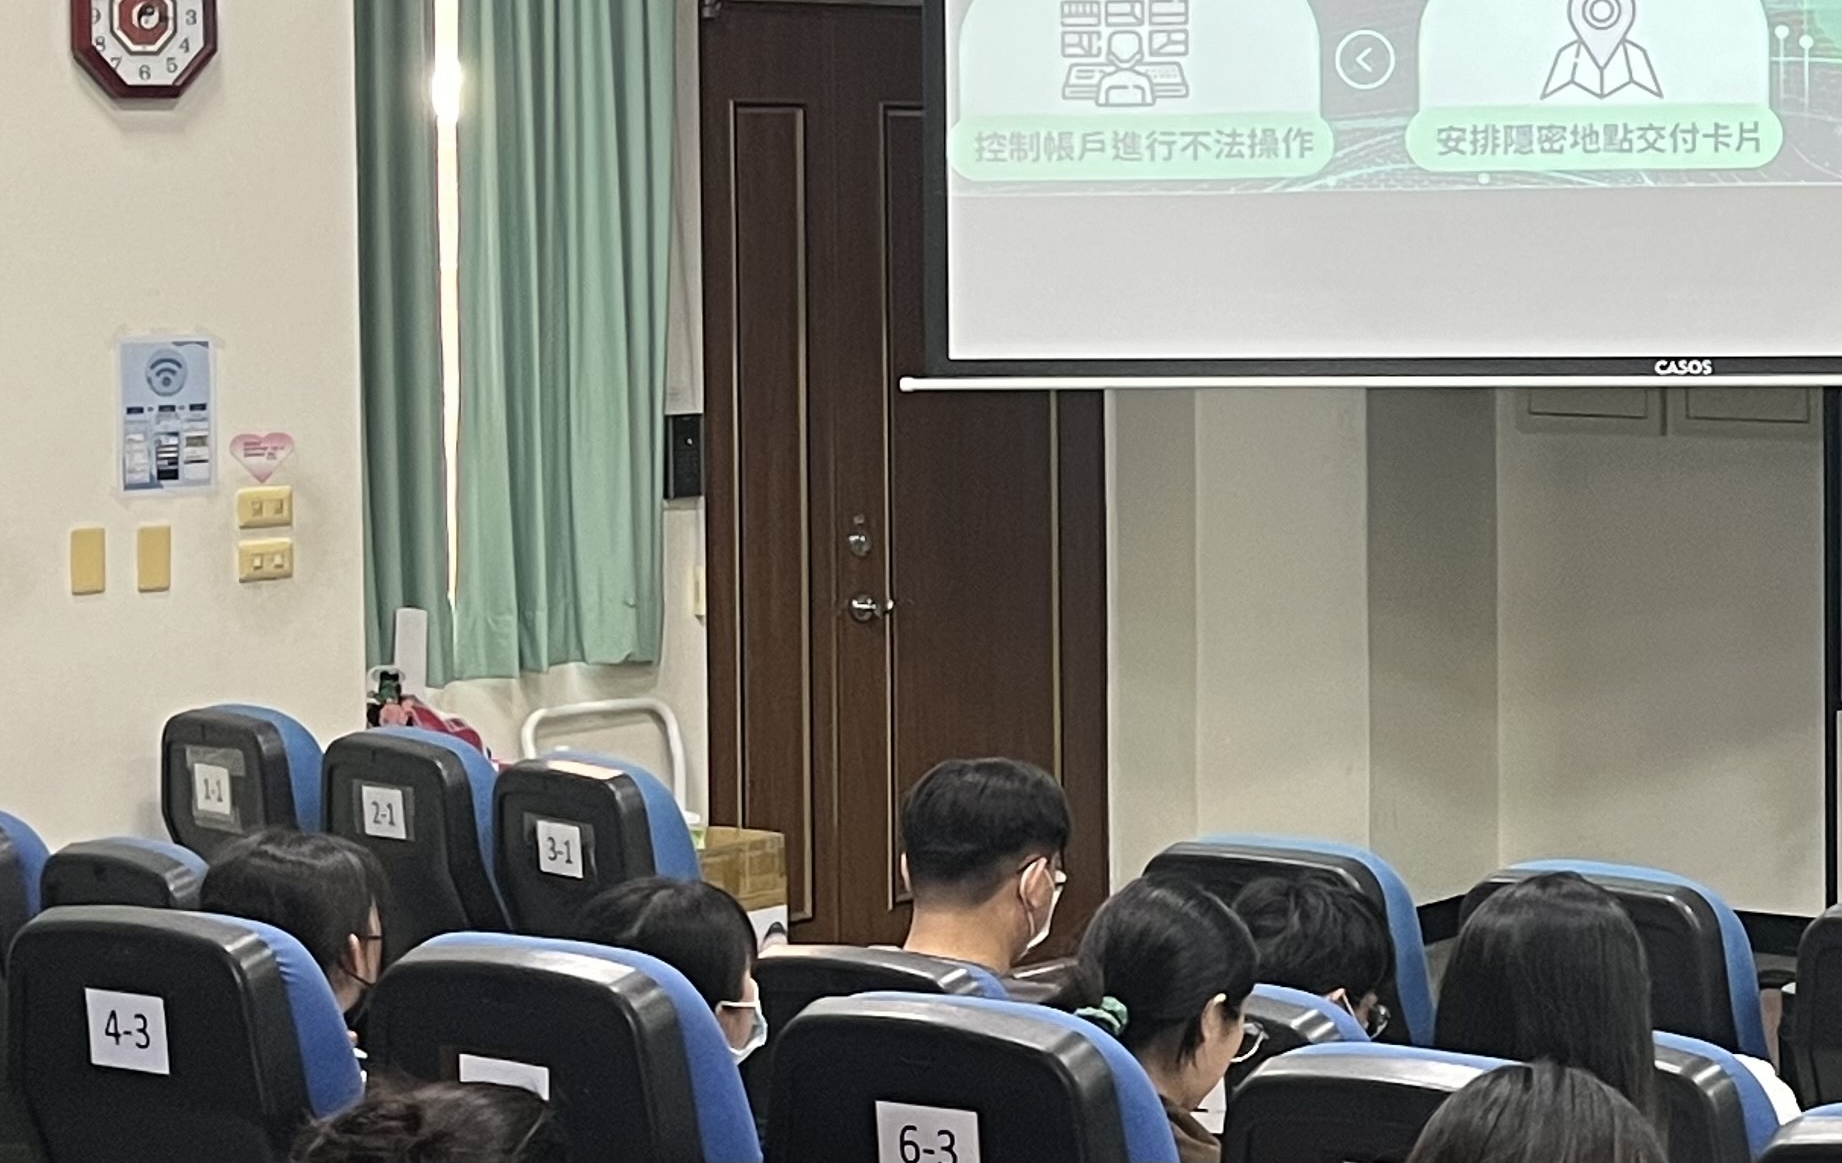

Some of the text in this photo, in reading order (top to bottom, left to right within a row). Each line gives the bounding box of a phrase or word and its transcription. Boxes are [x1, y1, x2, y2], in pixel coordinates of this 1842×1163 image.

[91, 9, 102, 24] 9
[185, 9, 197, 25] 3
[95, 36, 106, 51] 8
[179, 38, 190, 53] 4
[110, 57, 122, 71] 7
[166, 57, 178, 73] 5
[139, 65, 151, 80] 6
[974, 127, 1315, 164] 控制帳戶進行不法操作
[1436, 120, 1761, 156] 安排隱密地點交付卡片
[1654, 359, 1713, 375] CASOS
[203, 777, 224, 803] 1-1
[370, 800, 396, 827] 2-1
[547, 836, 574, 865] 3-1
[104, 1009, 151, 1049] 4-3
[899, 1124, 958, 1163] 6-3
